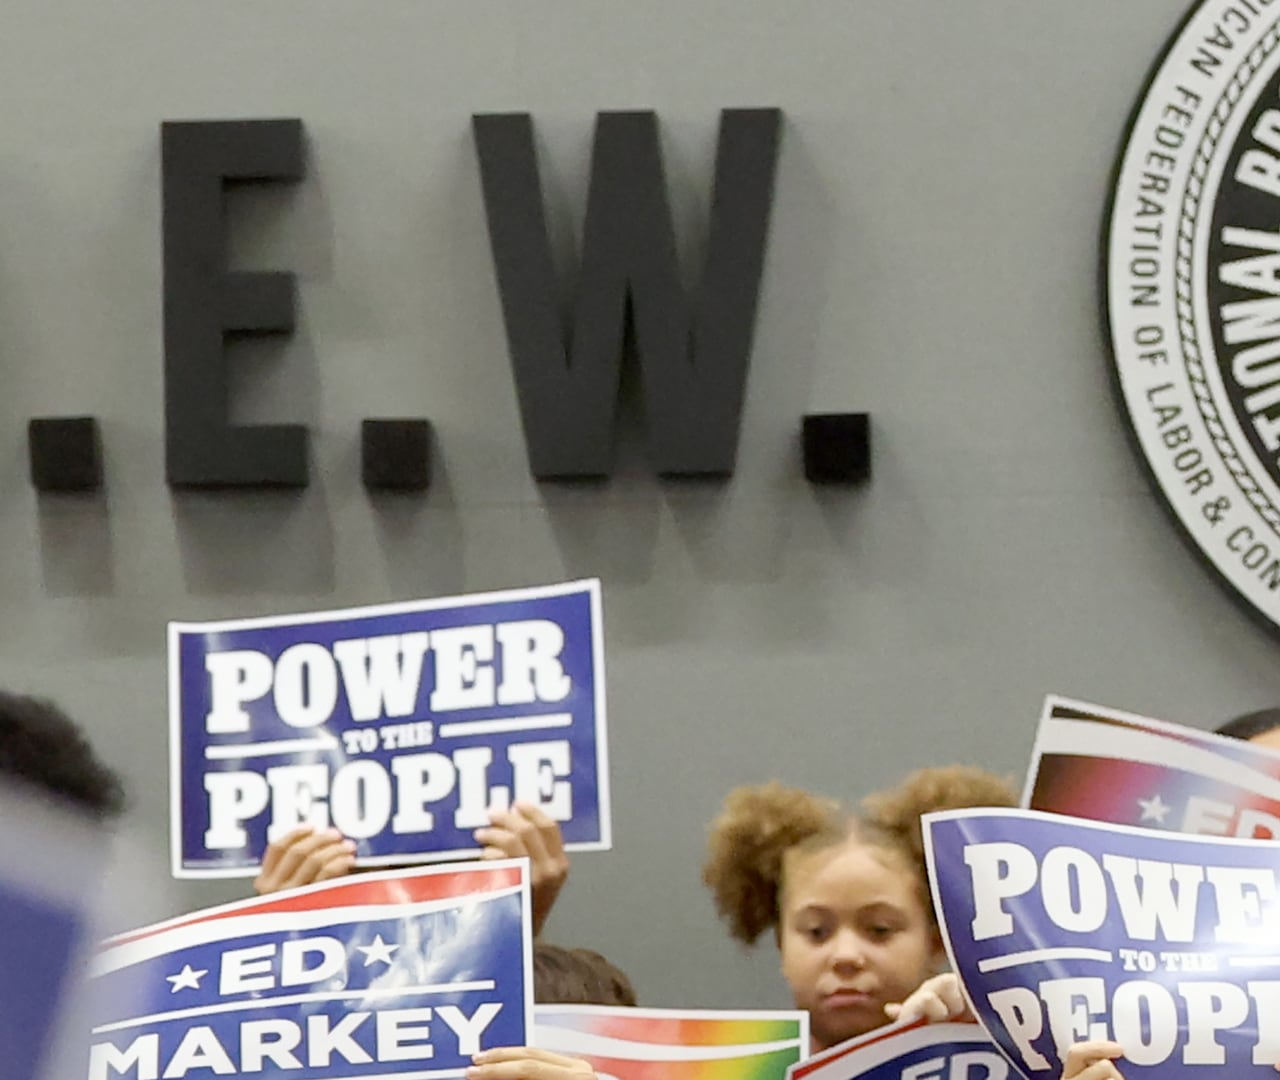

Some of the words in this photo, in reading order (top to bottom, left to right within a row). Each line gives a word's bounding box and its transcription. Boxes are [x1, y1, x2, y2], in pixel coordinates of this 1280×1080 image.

[1130, 85, 1200, 307] FEDERATION
[1134, 325, 1170, 368] OF
[1147, 382, 1216, 496] LABOR
[1203, 497, 1231, 529] &
[205, 618, 572, 735] POWER
[343, 728, 377, 755] TO
[380, 721, 433, 751] THE
[204, 740, 573, 850] PEOPLE
[218, 936, 347, 996] ED
[1119, 949, 1157, 972] TO
[1159, 951, 1218, 973] THE
